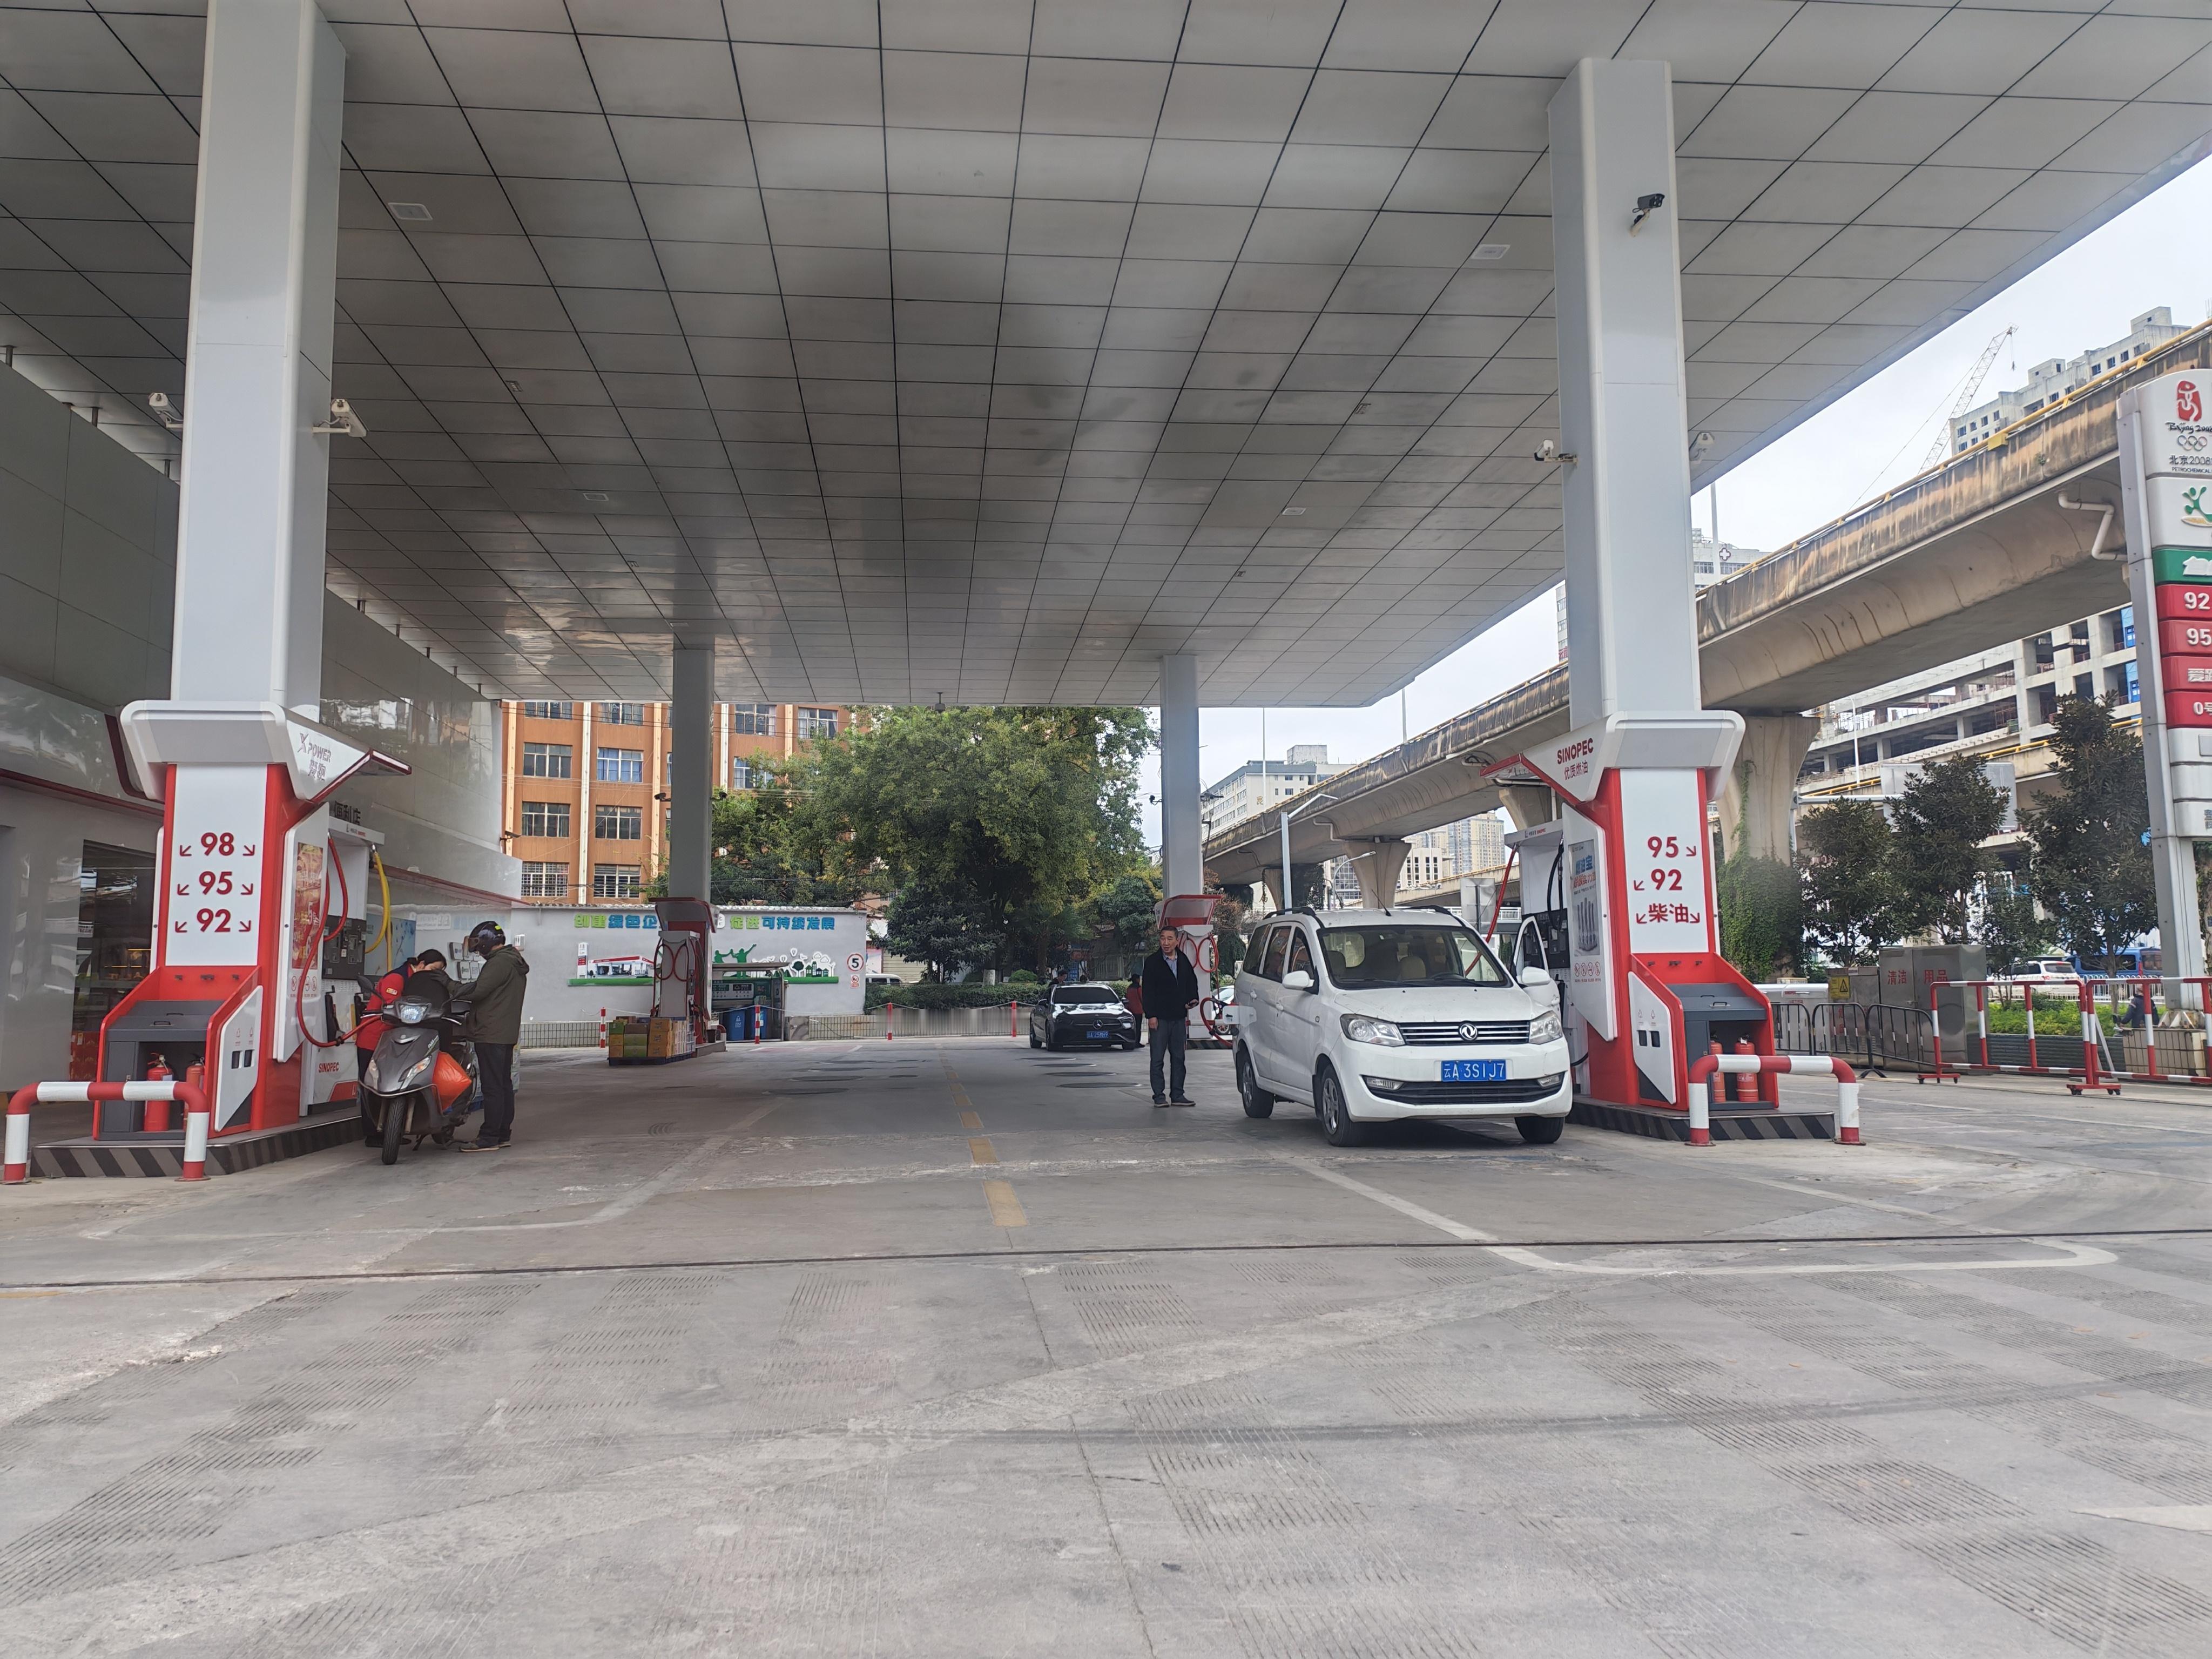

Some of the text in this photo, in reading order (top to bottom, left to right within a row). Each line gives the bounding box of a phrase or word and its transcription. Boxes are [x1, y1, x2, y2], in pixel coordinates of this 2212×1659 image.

[2169, 455, 2212, 465] 北京2008
[2184, 592, 2210, 610] 92
[2187, 628, 2212, 645] 95
[1557, 738, 1594, 764] SINOPEC
[1564, 760, 1588, 780] 优质燃油
[201, 832, 234, 856] 98
[1648, 836, 1679, 858] 95
[199, 871, 232, 895] 95
[1651, 868, 1682, 891] 92
[197, 908, 231, 932] 92
[574, 913, 662, 929] 创建绿色企
[1648, 903, 1689, 923] 柴油
[730, 916, 835, 930] 促进可持续发展
[851, 958, 859, 968] 5
[1888, 969, 1948, 985] 清洁 用品
[319, 1062, 340, 1073] SINOPEC
